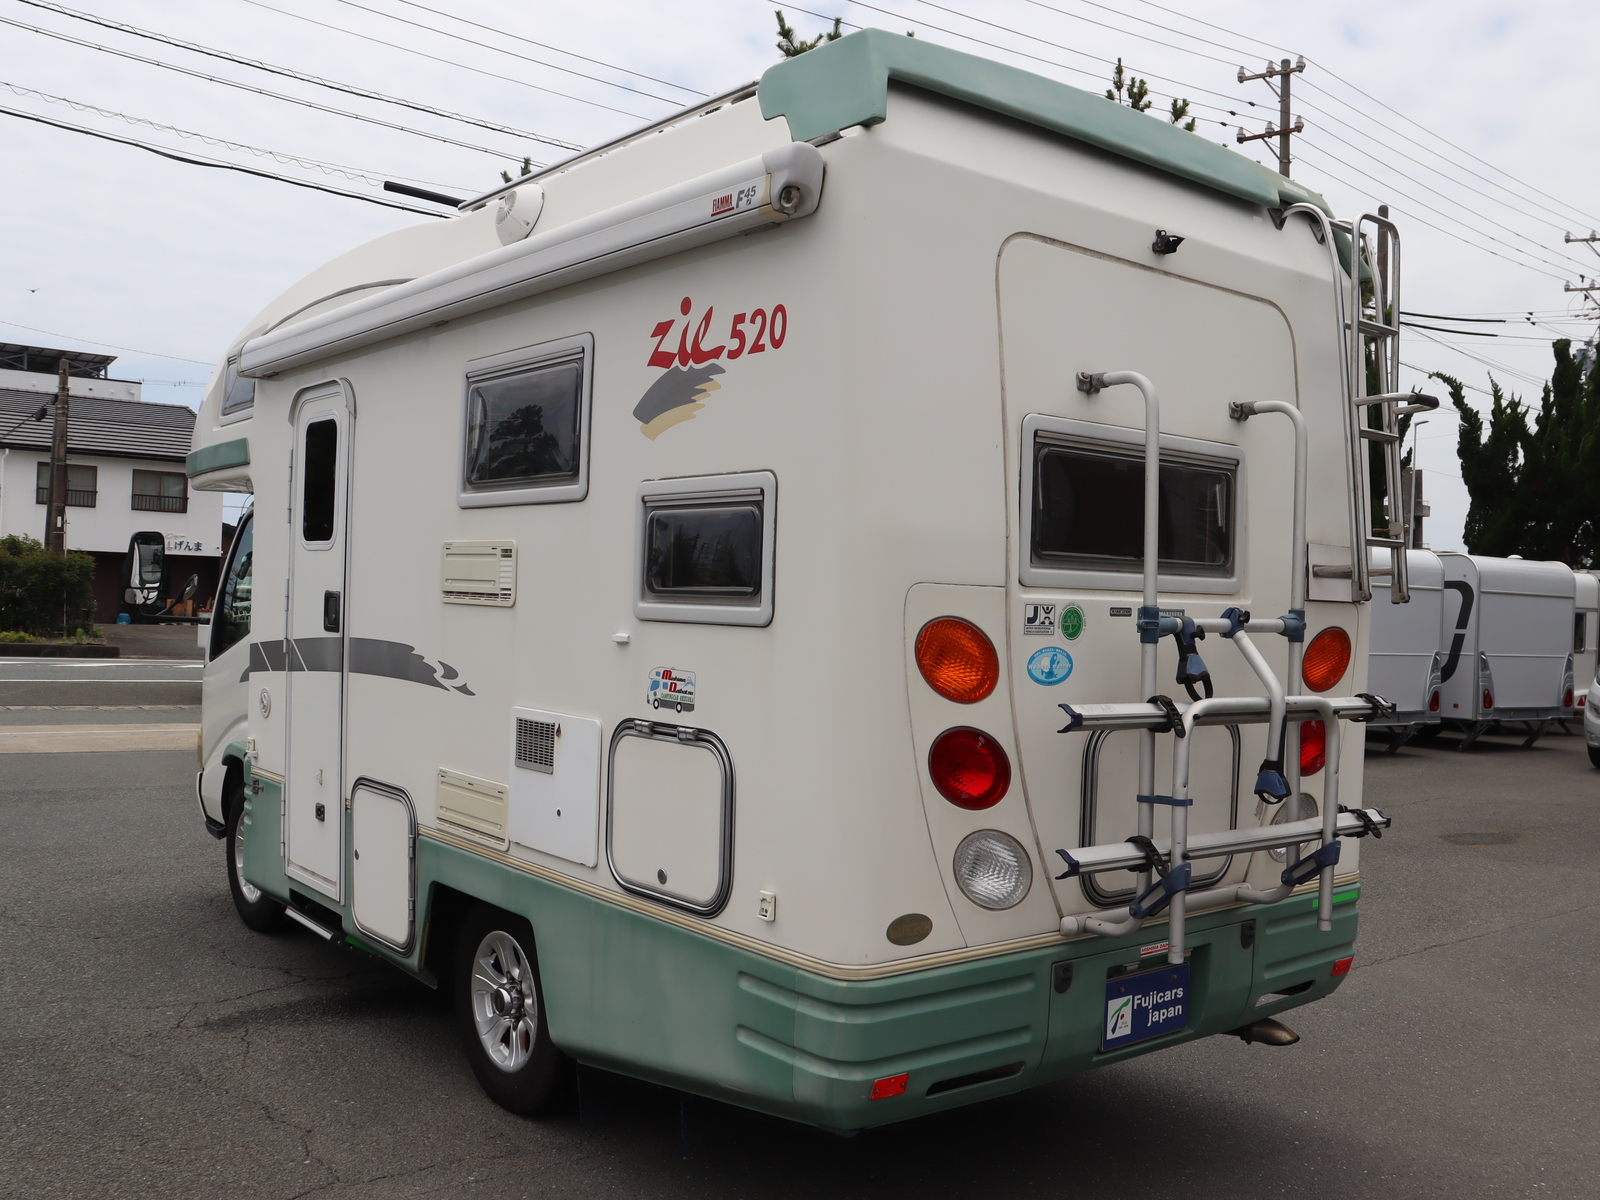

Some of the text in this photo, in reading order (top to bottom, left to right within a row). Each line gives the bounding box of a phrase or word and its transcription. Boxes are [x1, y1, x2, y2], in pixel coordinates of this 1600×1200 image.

[711, 193, 734, 213] FIAMMA
[727, 303, 787, 360] 520
[174, 540, 203, 552] げんま
[1133, 987, 1184, 1009] Fujicars
[1147, 1004, 1183, 1027] japan
